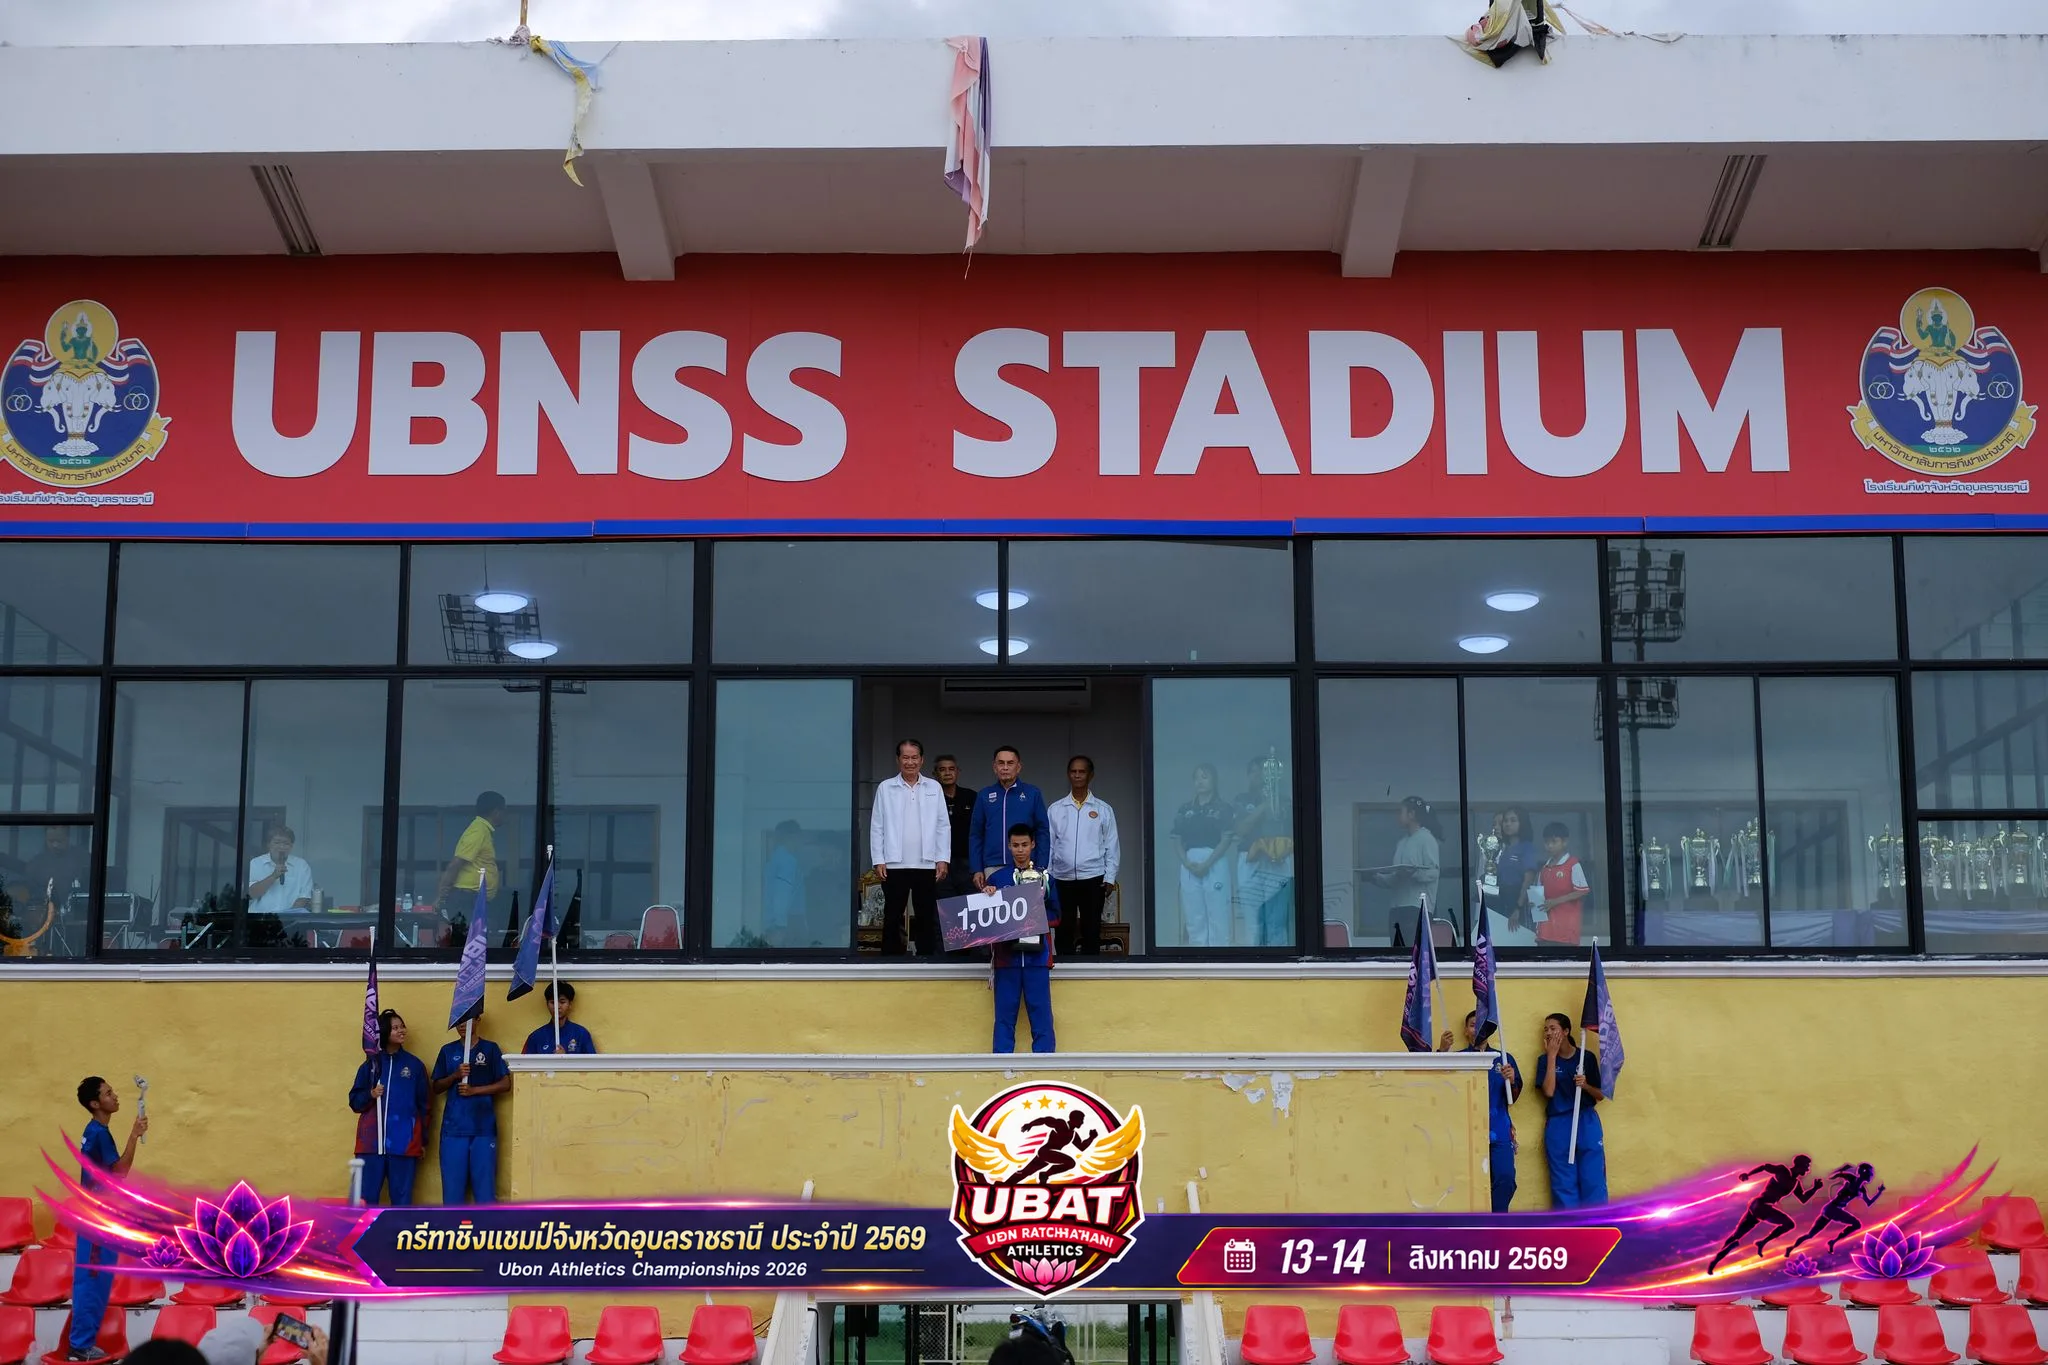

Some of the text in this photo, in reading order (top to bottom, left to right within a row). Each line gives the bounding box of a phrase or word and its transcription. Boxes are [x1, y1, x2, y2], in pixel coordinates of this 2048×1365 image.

[231, 327, 1791, 482] UBNSS STADIUM
[5, 443, 147, 481] มหาวิทยาลัยการกีฬาแห่งชาติ
[1873, 431, 2016, 469] มหาวิทยาลัยการกีฬาแห่งชาติ
[0, 491, 153, 506] รงเรียนกีฬาจังหวัดอุบลราชธานี
[1865, 480, 2028, 495] โรงเรียนกีฬาจังหวัดอุบลราชธานี
[957, 897, 1028, 933] 1,000
